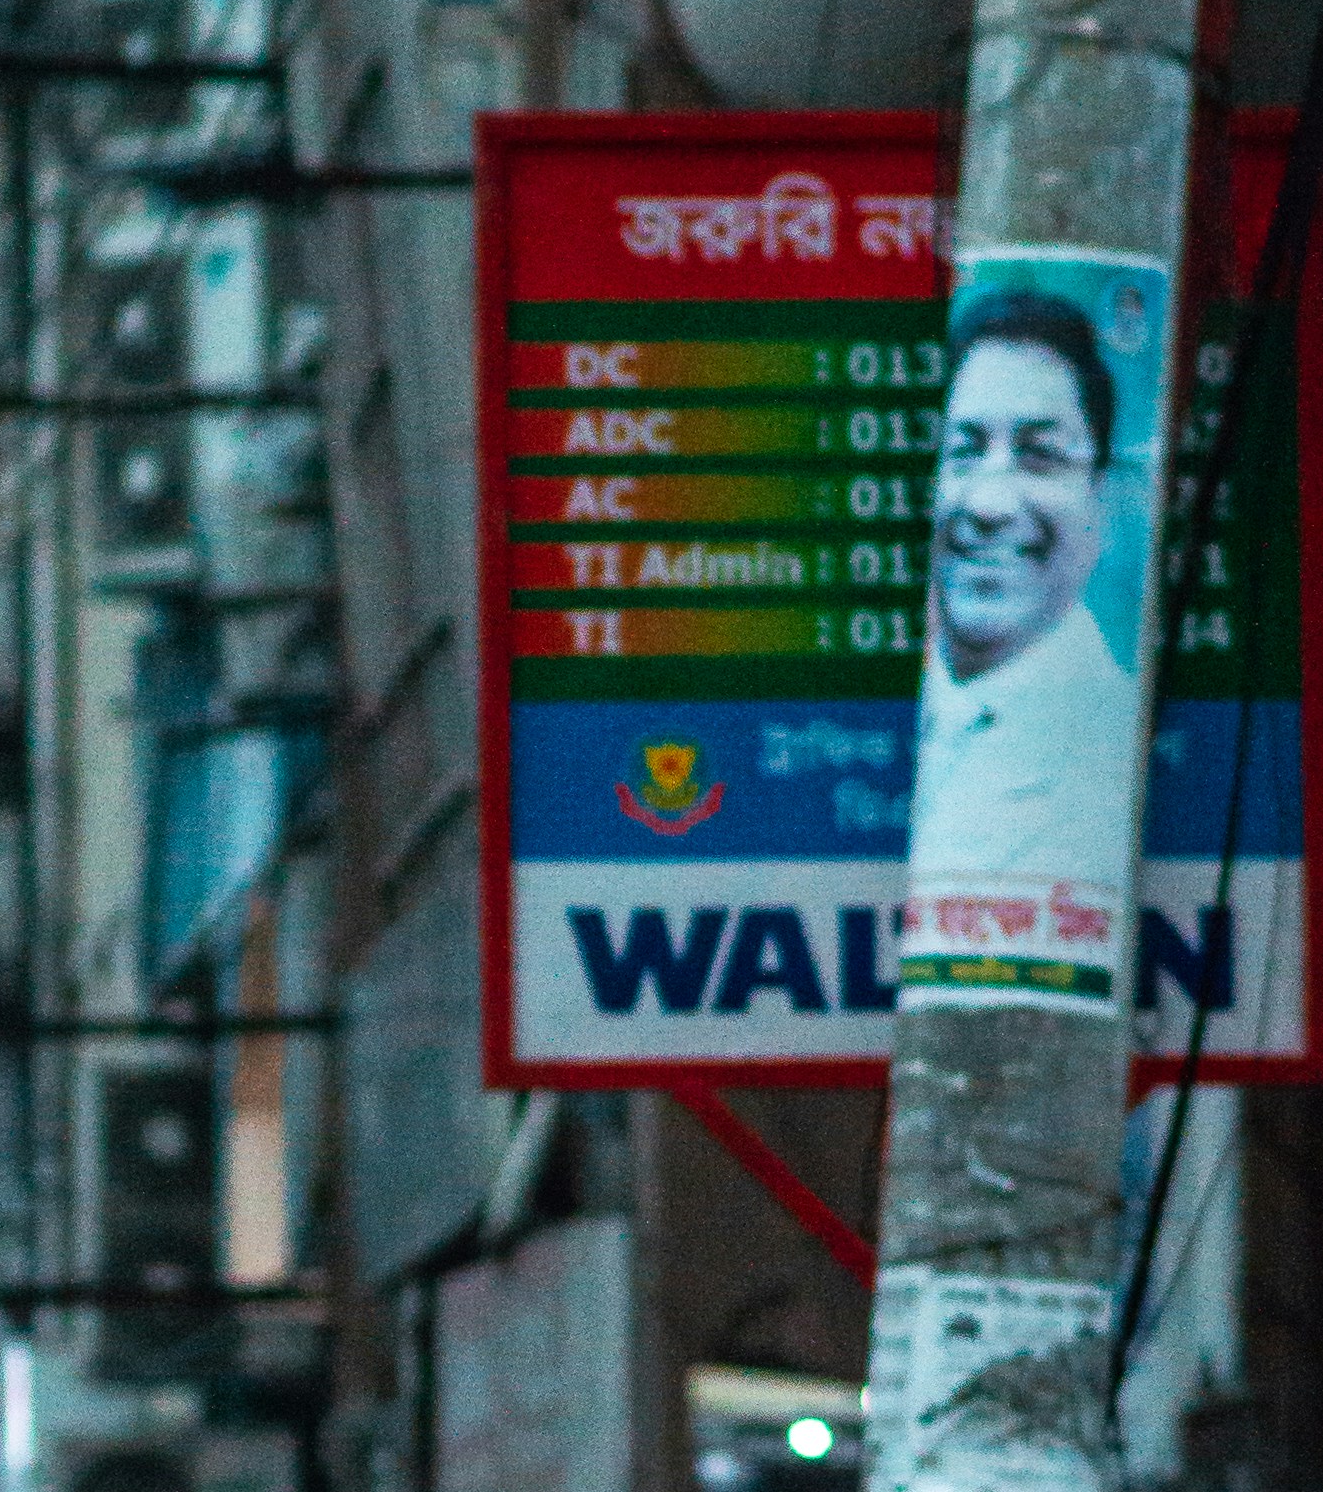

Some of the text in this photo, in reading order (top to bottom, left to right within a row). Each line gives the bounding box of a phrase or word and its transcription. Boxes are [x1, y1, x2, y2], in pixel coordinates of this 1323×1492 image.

[618, 172, 838, 263] জরুরি
[566, 344, 639, 388] DC
[566, 410, 675, 454] ADC
[566, 477, 635, 520] AC
[564, 544, 622, 587] TI
[639, 542, 803, 586] Admin
[564, 610, 622, 655] TI
[567, 905, 1235, 1015] WALN
